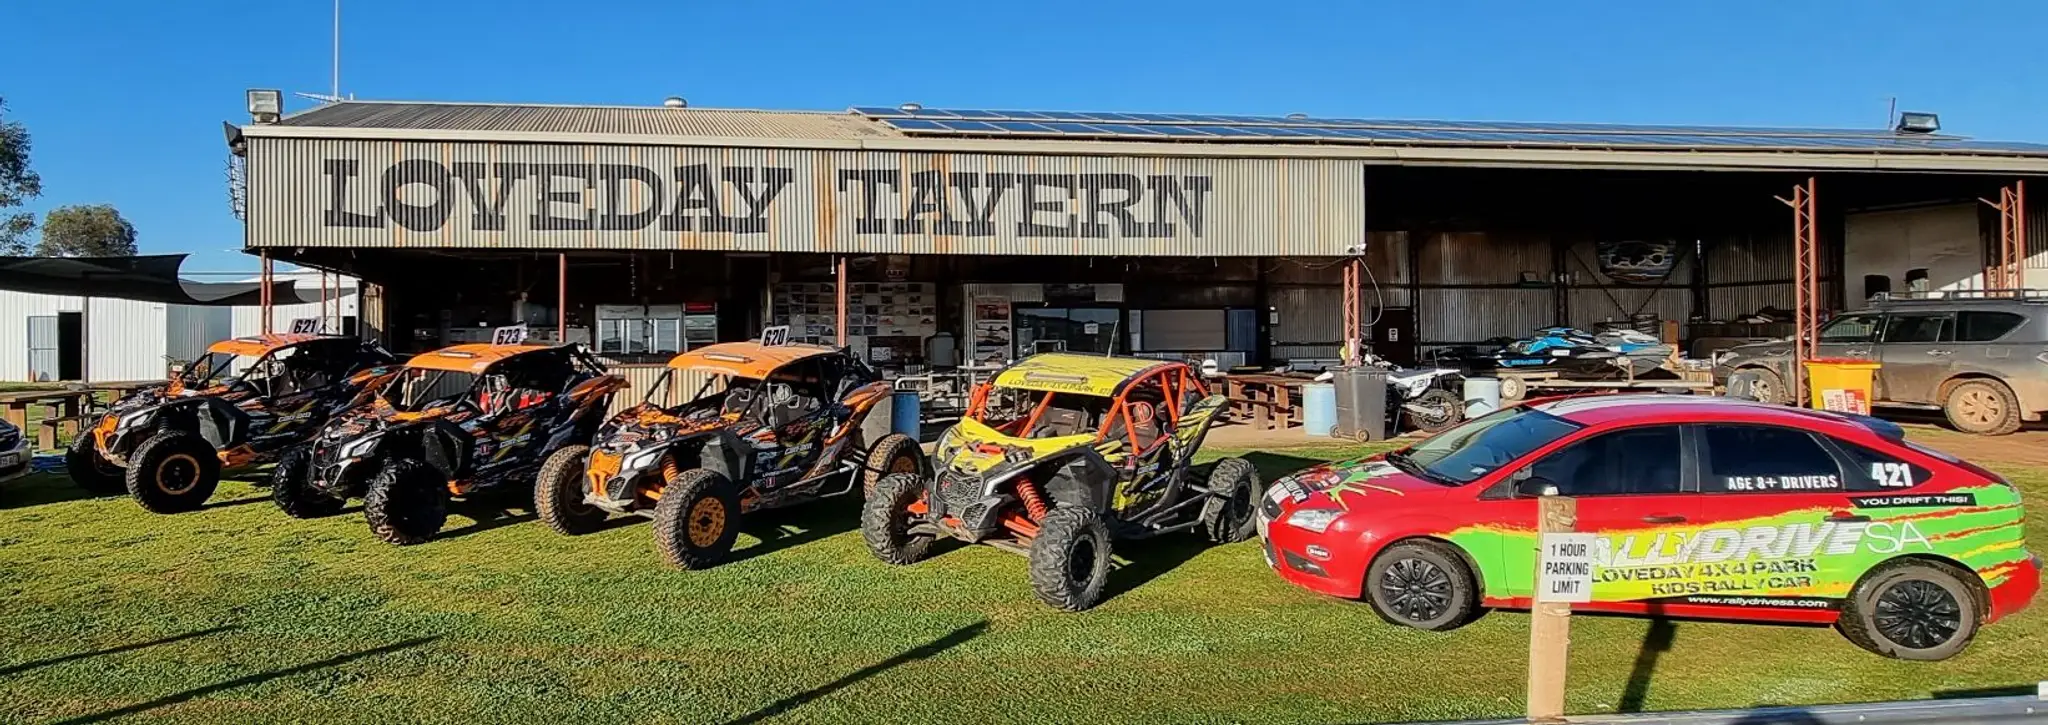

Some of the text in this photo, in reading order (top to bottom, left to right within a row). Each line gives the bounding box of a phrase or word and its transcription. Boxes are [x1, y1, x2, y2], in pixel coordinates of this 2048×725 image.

[324, 158, 1212, 239] LOVEDAY TAVERN
[293, 319, 317, 334] 621
[496, 328, 520, 345] 623
[763, 329, 785, 347] 620
[1728, 474, 1838, 490] AGE 8+ DRIVERS
[1871, 462, 1913, 487] 421
[1860, 495, 1968, 507] YOU DRIFT THIS!
[1551, 543, 1587, 557] 1 HOUR
[1545, 561, 1589, 576] PARKING
[1592, 564, 1696, 583] LOVEDAY
[1752, 558, 1817, 575] PARK
[1552, 580, 1581, 594] LIMIT
[1652, 576, 1811, 595] KIDS RALLY CAR
[1688, 596, 1828, 608] www.rallydrivesa.com
